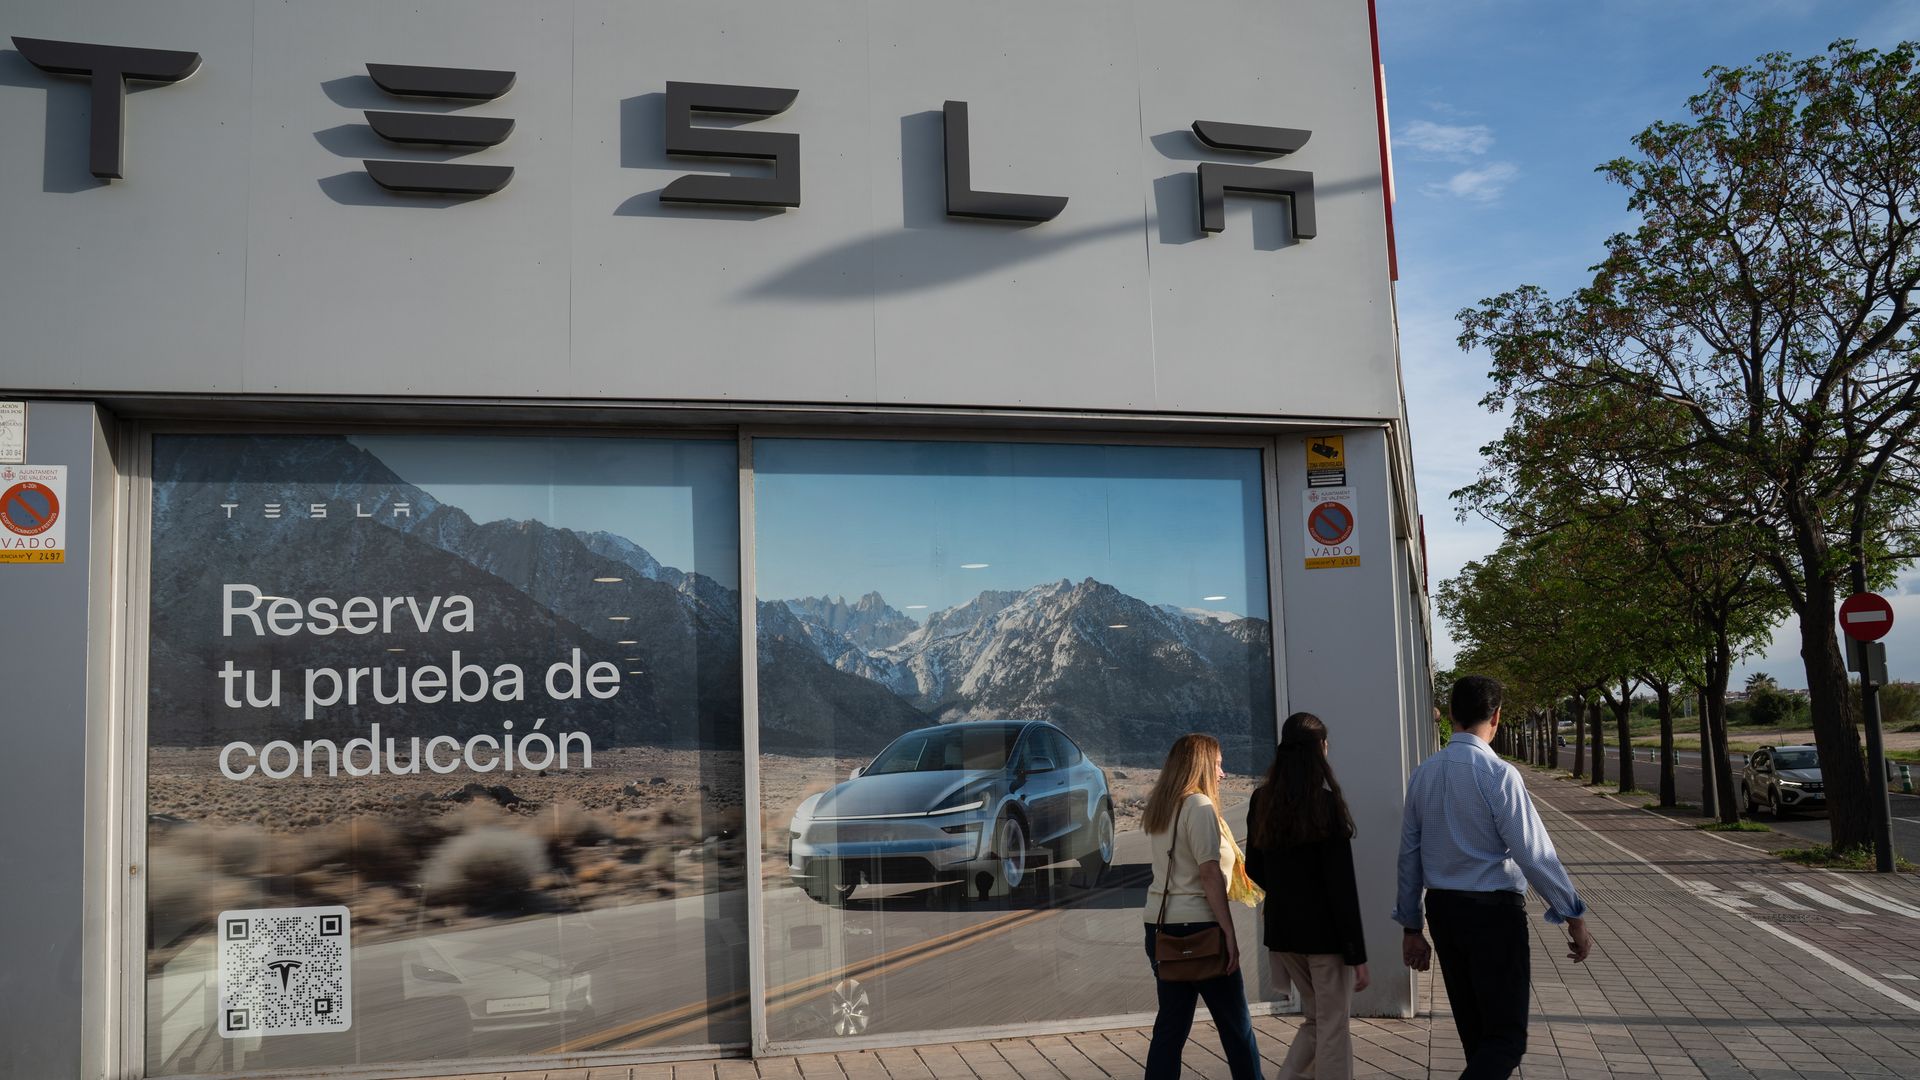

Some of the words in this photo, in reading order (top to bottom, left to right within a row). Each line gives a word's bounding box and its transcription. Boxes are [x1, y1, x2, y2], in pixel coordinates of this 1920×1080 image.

[11, 35, 1318, 242] TESLA
[220, 503, 410, 519] TESLA
[1, 537, 56, 549] VADO
[25, 552, 33, 561] Y
[39, 552, 61, 561] 2497
[1312, 546, 1353, 557] VADO
[222, 583, 475, 637] Reserva
[219, 660, 281, 708] tu
[304, 650, 525, 720] prueba
[545, 647, 621, 701] de
[219, 719, 593, 781] conducción
